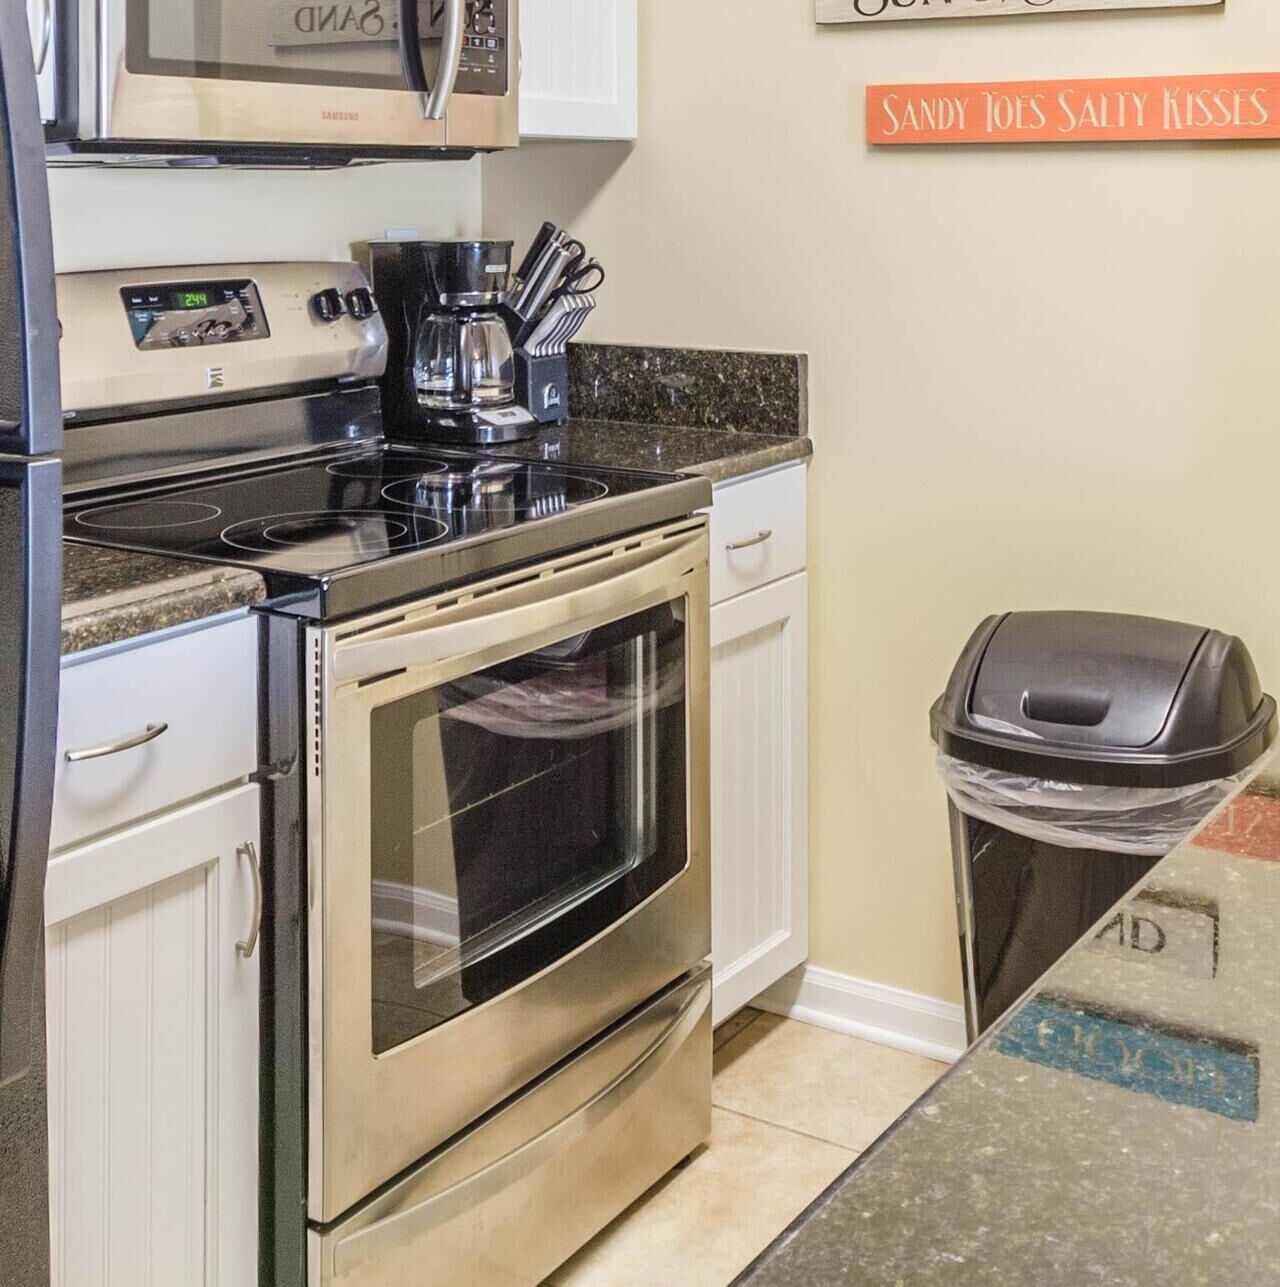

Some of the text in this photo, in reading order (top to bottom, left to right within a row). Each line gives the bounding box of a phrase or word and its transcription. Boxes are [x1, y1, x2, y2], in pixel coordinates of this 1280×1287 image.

[882, 85, 1269, 136] SANDY TOES SALTY KISSES
